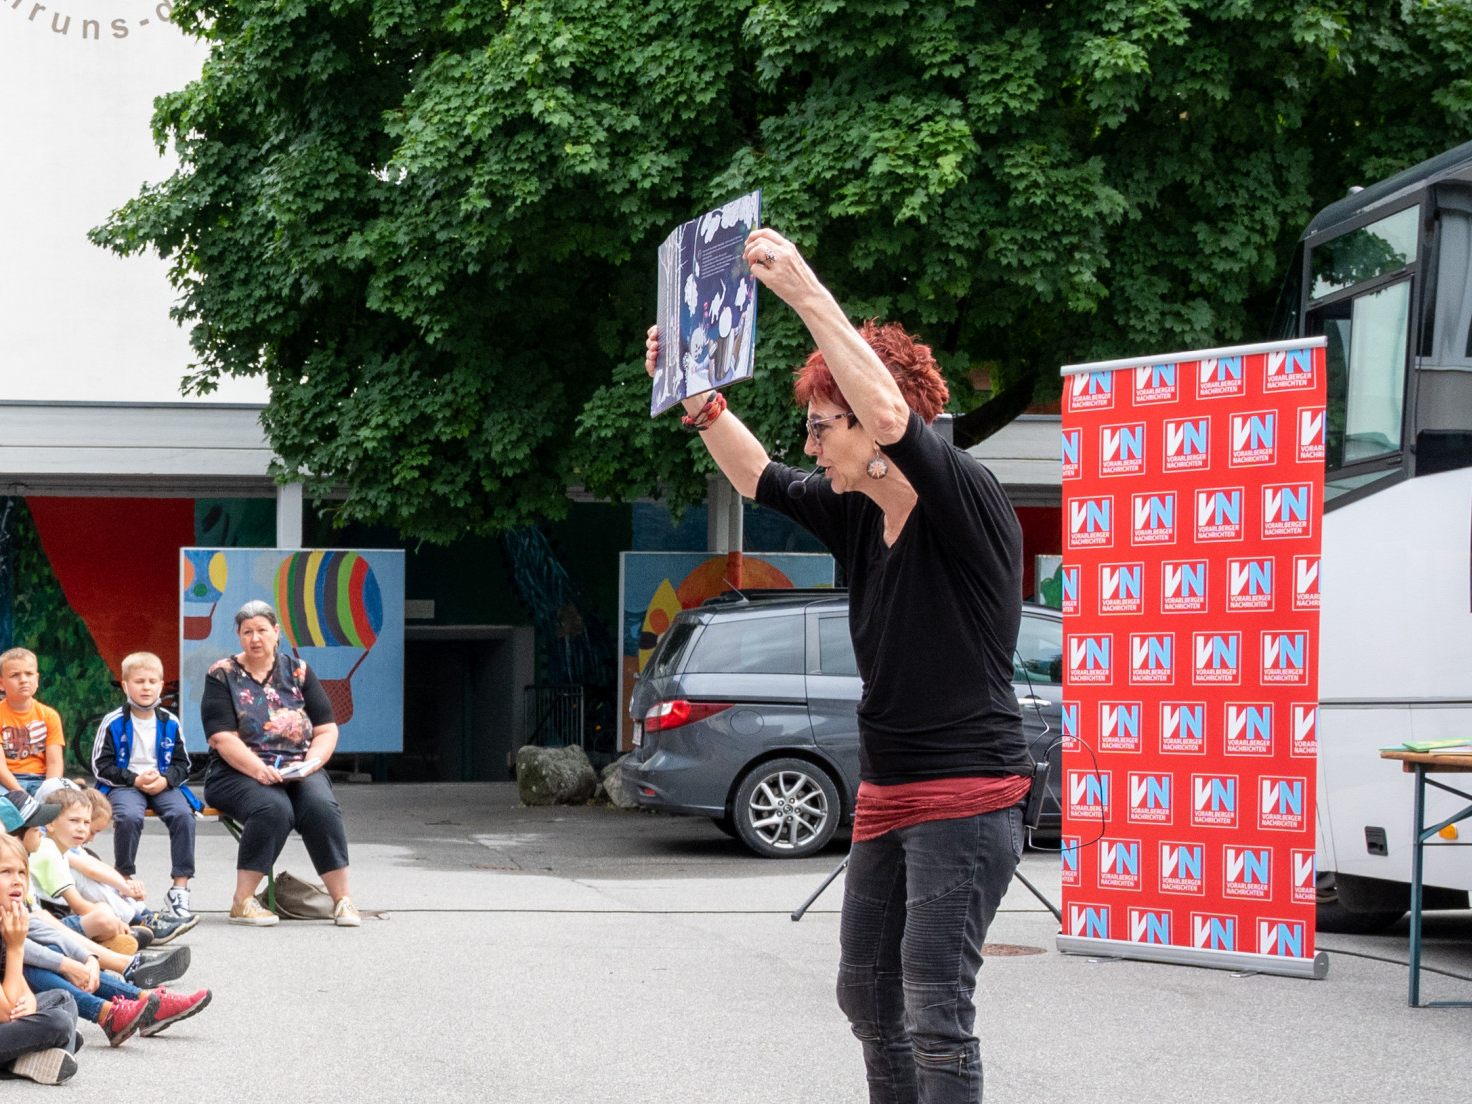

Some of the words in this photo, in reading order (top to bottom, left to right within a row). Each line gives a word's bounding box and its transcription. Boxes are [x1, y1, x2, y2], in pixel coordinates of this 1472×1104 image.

[1136, 387, 1175, 396] VORARLBERGER
[1200, 379, 1241, 389] VORARLBERGER
[1200, 385, 1238, 395] NACHRICHTEN
[1267, 378, 1307, 388] NACHRICHTEN
[1268, 372, 1312, 383] VORARLBERGER
[1072, 393, 1111, 403] VORARLBERGER
[1072, 399, 1107, 408] NACHRICHTEN
[1136, 392, 1171, 402] NACHRICHTEN
[1103, 427, 1142, 461] VN
[1167, 421, 1206, 455] VN
[1233, 415, 1272, 450] VN
[1103, 459, 1142, 468] VORARLBERGER
[1166, 460, 1202, 468] NACHRICHTEN
[1167, 454, 1206, 463] VORARLBERGER
[1233, 449, 1272, 458] VORARLBERGER
[1233, 454, 1268, 463] NACHRICHTEN
[1103, 465, 1138, 473] NACHRICHTEN
[1071, 501, 1108, 533] VN
[1134, 497, 1172, 530] VN
[1198, 493, 1240, 527] VN
[1265, 487, 1308, 523] VN
[1198, 525, 1239, 533] VORARLBERGER
[1265, 521, 1307, 530] VORARLBERGER
[1265, 527, 1302, 535] NACHRICHTEN
[1102, 567, 1140, 599] VN
[1164, 565, 1204, 597] VN
[1230, 561, 1270, 596] VN
[1070, 639, 1108, 669] VN
[1132, 637, 1170, 668] VN
[1196, 636, 1236, 668] VN
[1264, 635, 1304, 668] VN
[1102, 706, 1138, 736] VN
[1163, 706, 1202, 738] VN
[1228, 707, 1270, 738] VN
[1070, 775, 1108, 804] VN
[1131, 776, 1168, 808] VN
[1194, 778, 1234, 810] VN
[1262, 779, 1302, 814] VN
[1262, 819, 1297, 827] NACHRICHTEN
[1101, 841, 1136, 874] VN
[1162, 844, 1200, 878] VN
[1226, 849, 1268, 884] VN
[1162, 878, 1201, 886] VORARLBERGER
[1162, 883, 1197, 891] NACHRICHTEN
[1226, 888, 1264, 896] NACHRICHTEN
[1227, 883, 1268, 891] VORARLBERGER
